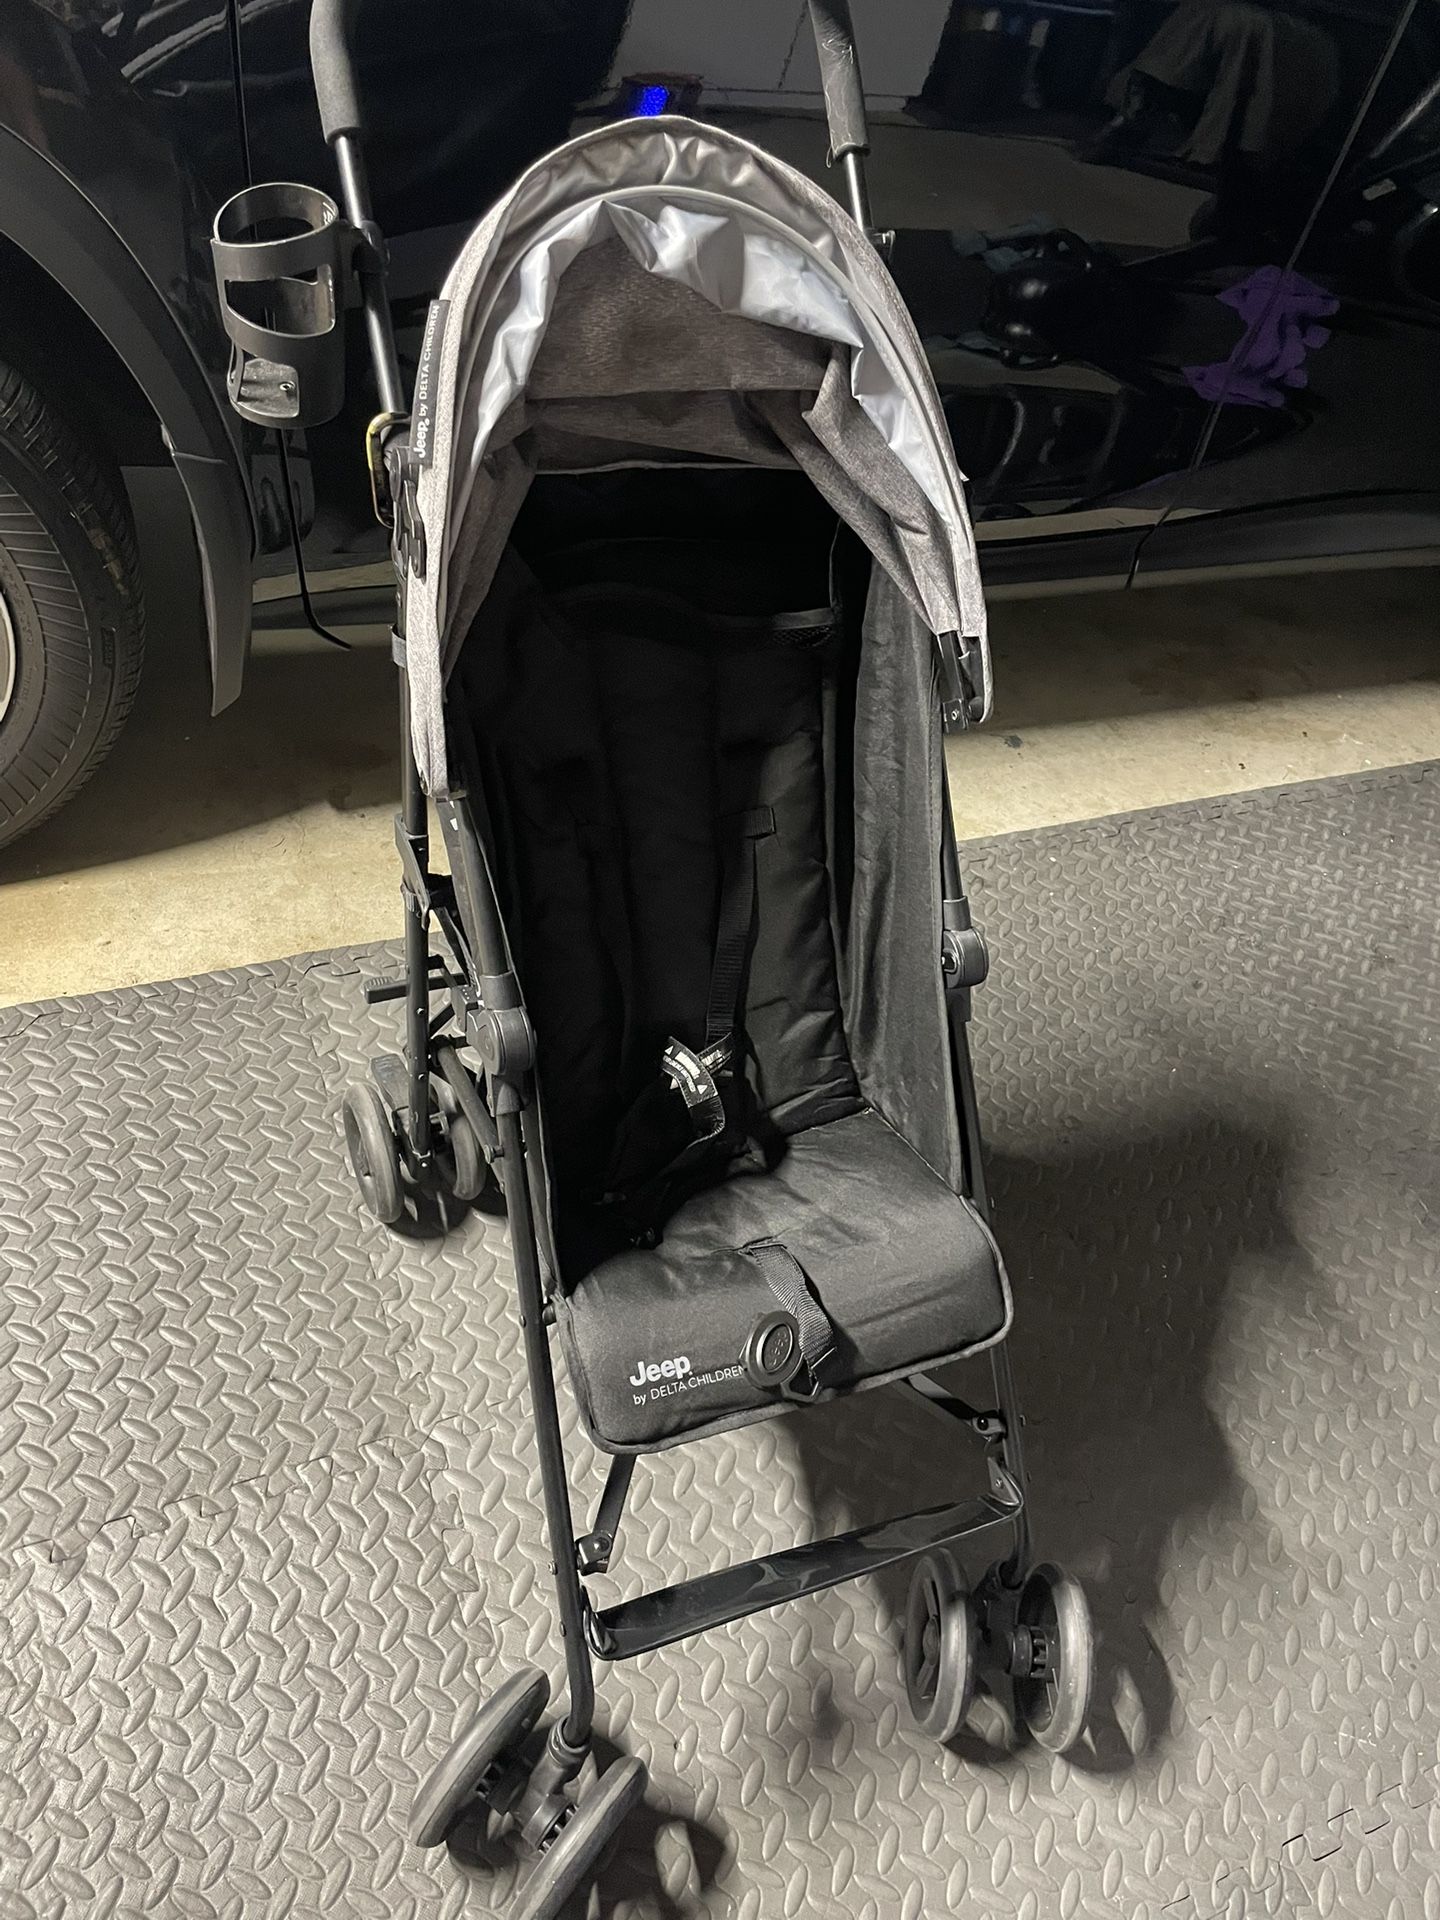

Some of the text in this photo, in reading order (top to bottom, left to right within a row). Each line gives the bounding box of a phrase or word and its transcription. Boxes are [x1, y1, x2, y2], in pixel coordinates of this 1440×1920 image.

[414, 305, 440, 459] Jeep by DELTA CHILDREN
[630, 1356, 691, 1386] Jeep
[633, 1394, 646, 1406] by
[650, 1382, 688, 1400] DELTA
